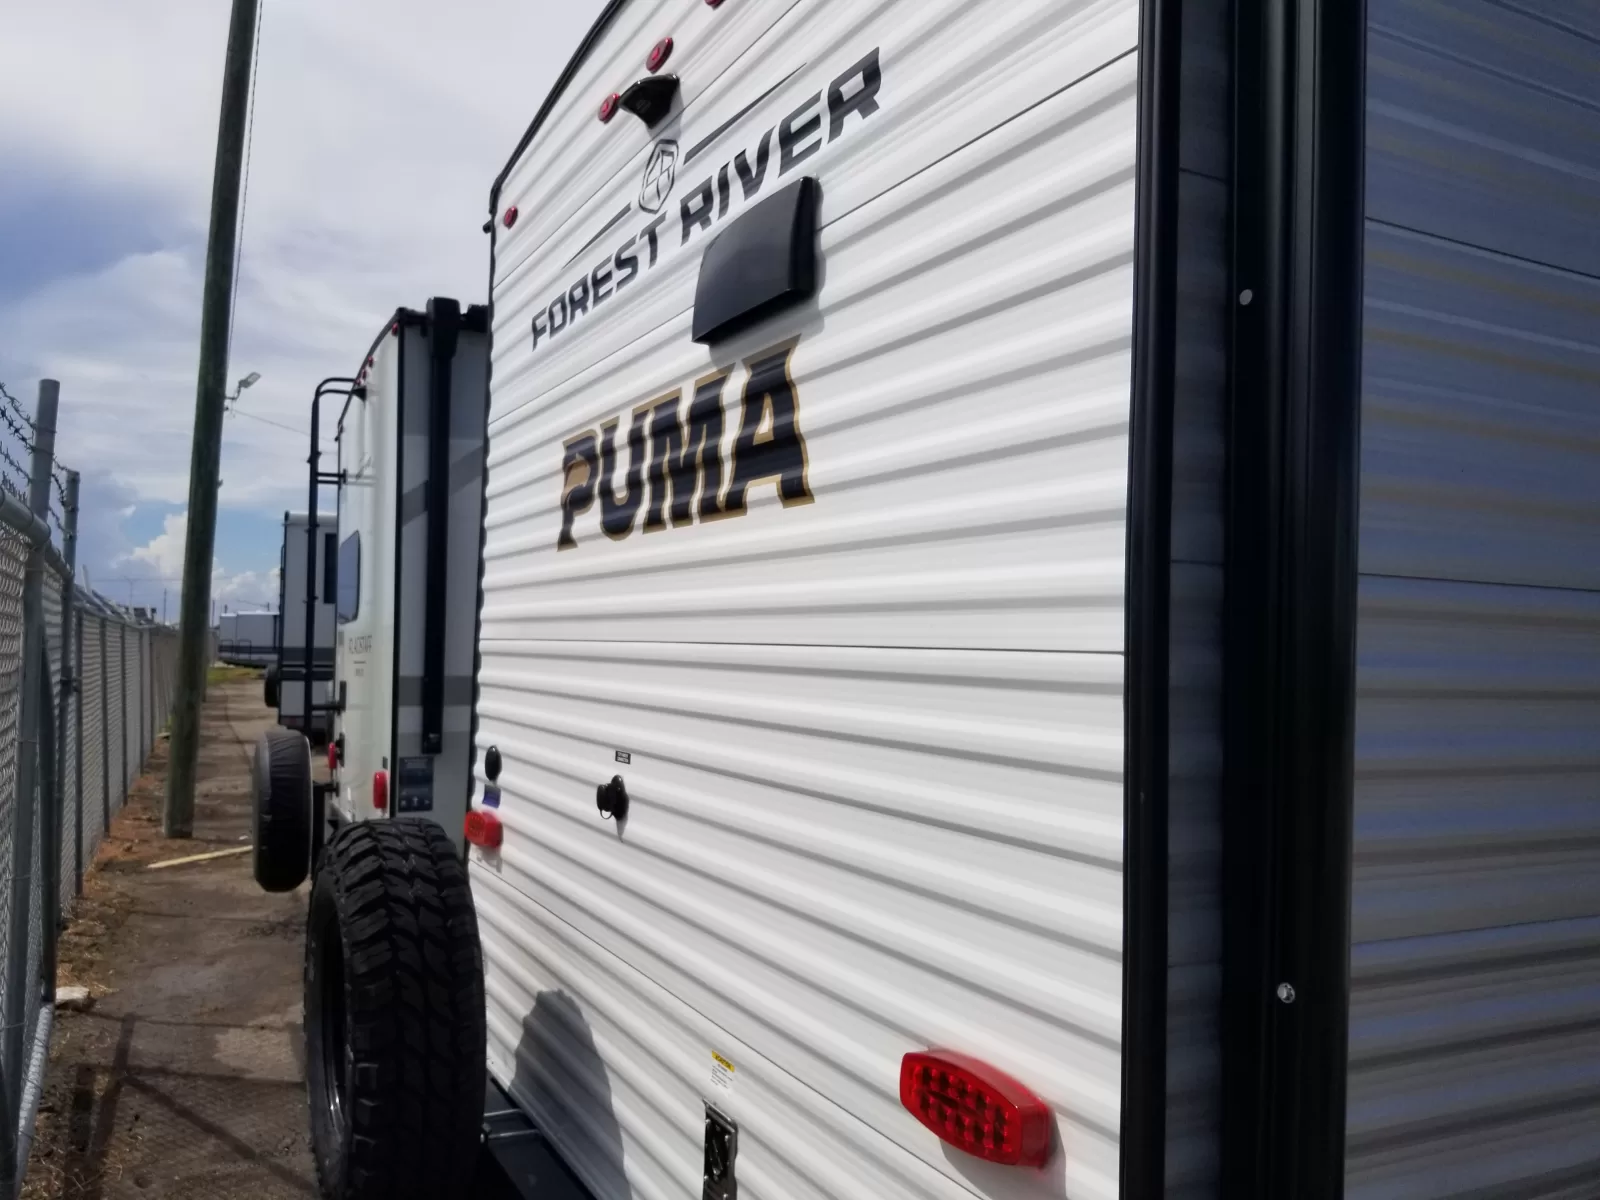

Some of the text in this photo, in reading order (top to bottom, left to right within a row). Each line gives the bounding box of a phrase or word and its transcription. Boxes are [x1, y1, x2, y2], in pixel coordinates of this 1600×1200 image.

[532, 46, 882, 352] FOREST RIVER
[556, 333, 816, 553] PUMA
